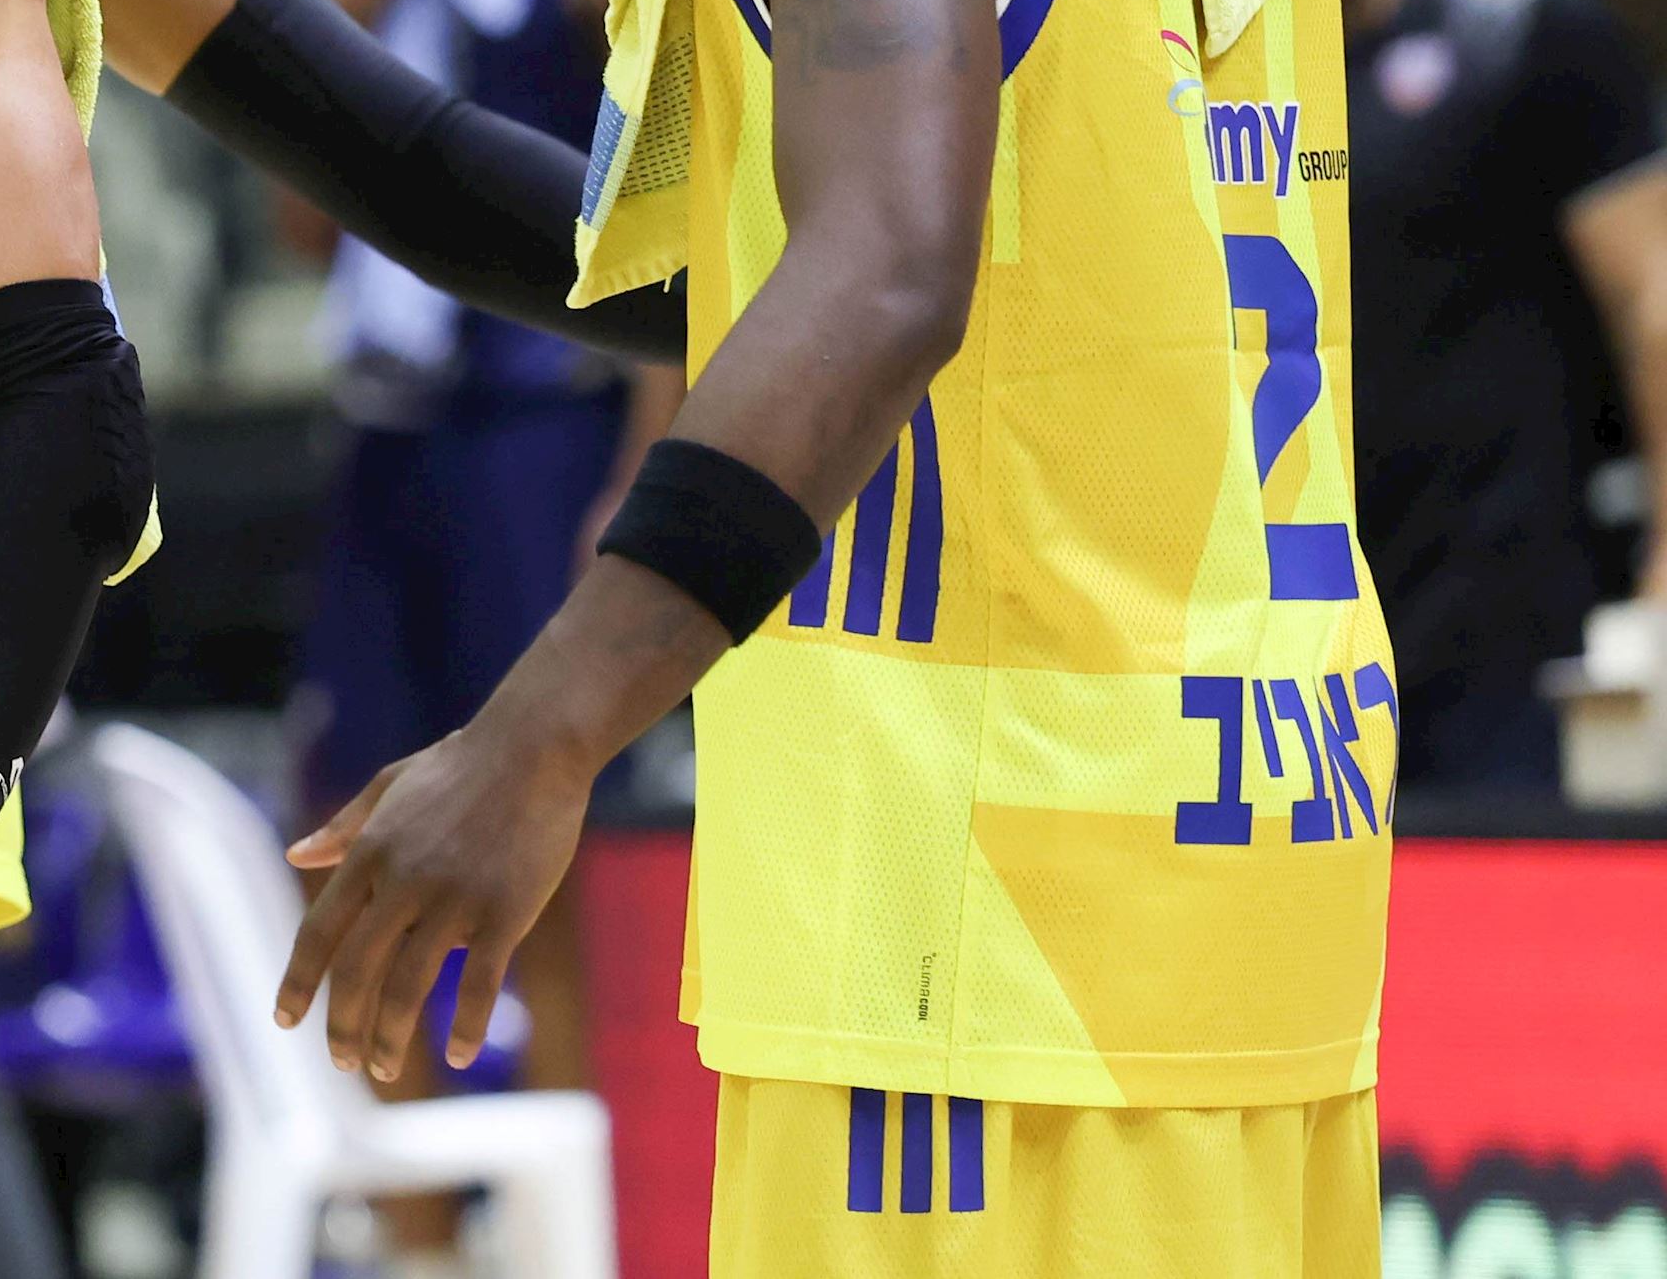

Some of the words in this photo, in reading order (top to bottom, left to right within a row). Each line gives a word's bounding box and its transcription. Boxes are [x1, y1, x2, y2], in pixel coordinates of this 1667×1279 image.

[1205, 101, 1299, 197] my
[1298, 149, 1347, 181] GROUP
[1223, 234, 1359, 600] 2
